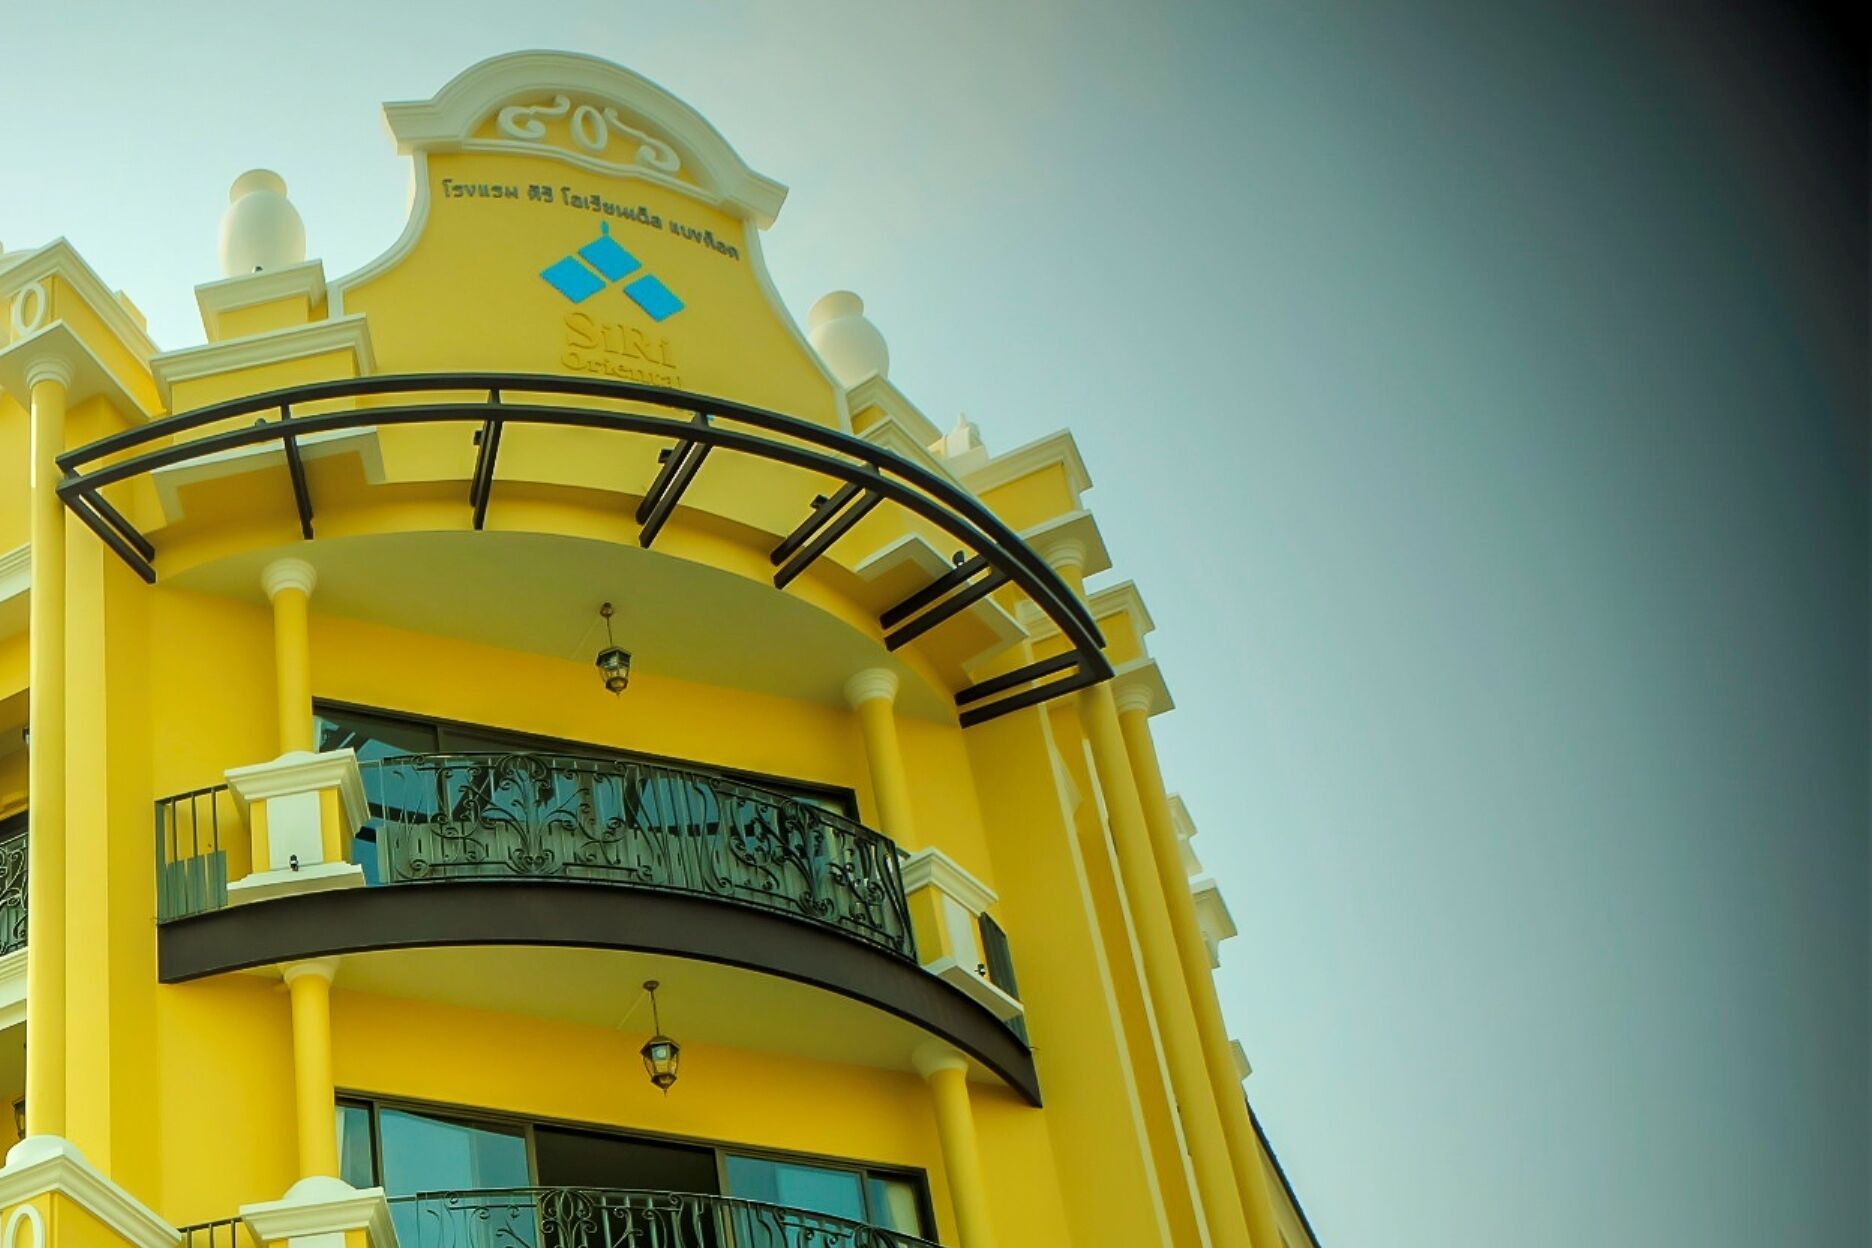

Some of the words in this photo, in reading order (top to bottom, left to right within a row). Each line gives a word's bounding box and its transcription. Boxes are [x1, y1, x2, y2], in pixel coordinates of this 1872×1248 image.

[441, 177, 519, 200] โรงแรม
[562, 311, 677, 369] SiRi
